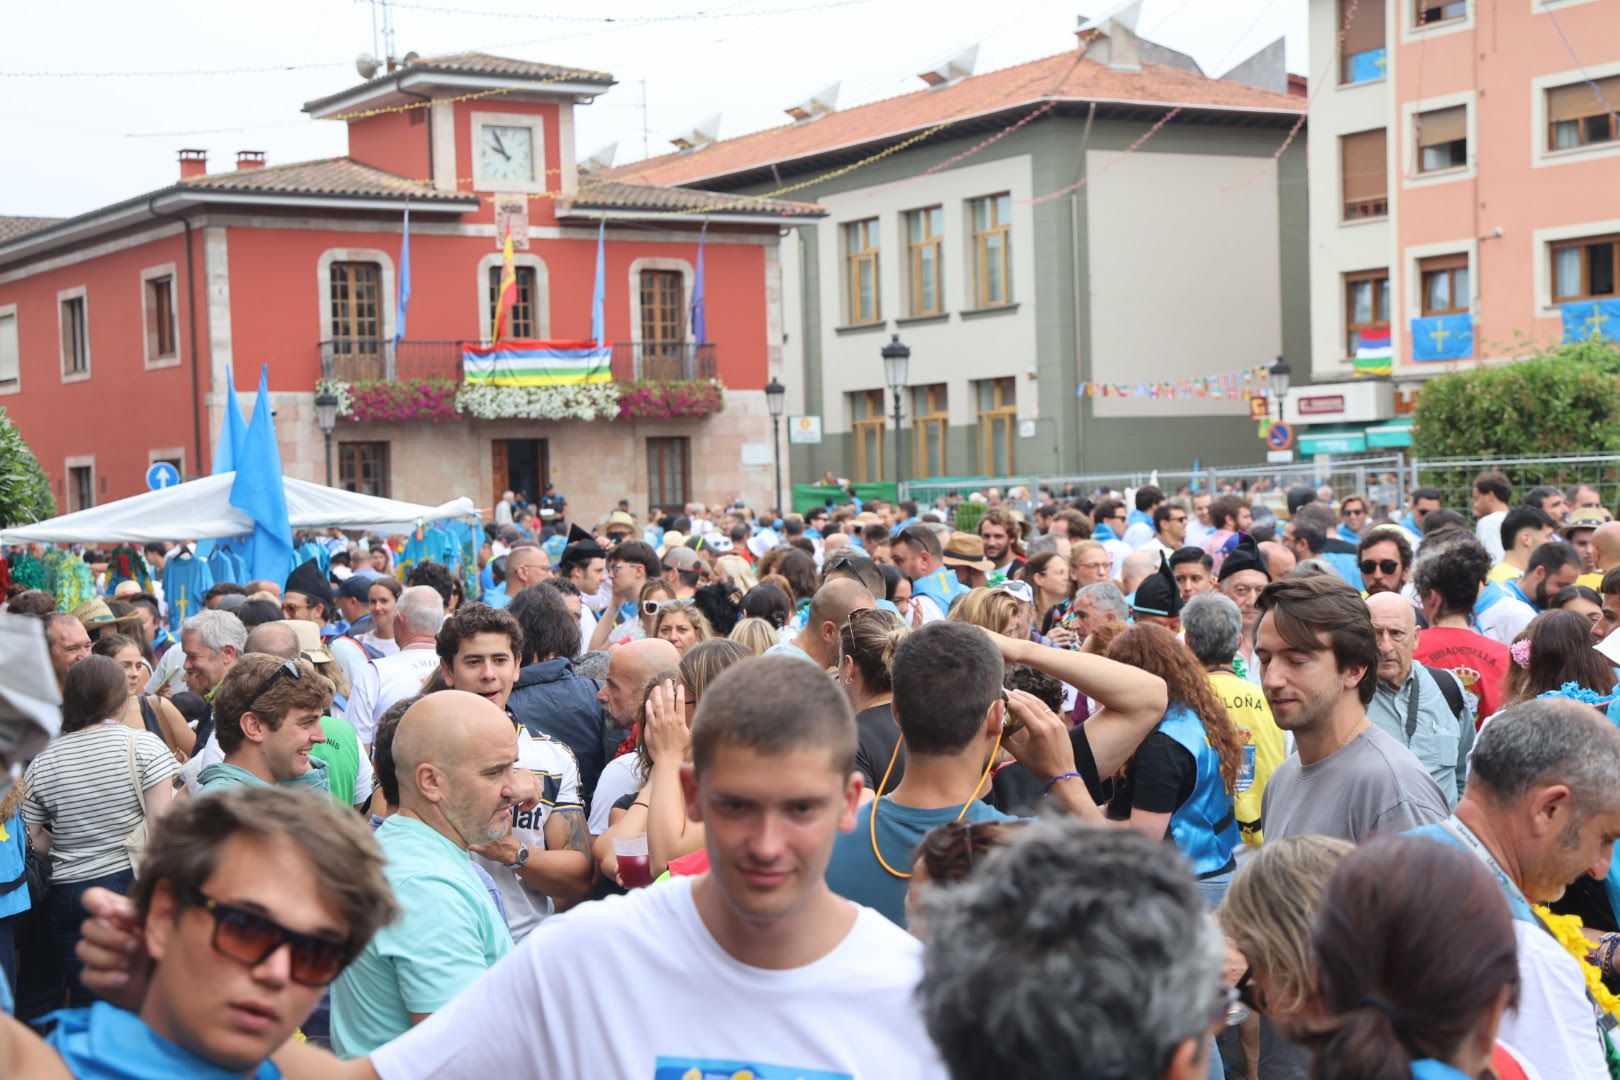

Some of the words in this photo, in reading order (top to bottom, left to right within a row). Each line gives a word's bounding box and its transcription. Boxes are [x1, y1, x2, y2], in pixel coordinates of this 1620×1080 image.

[1429, 646, 1497, 667] RIBADESELLA
[1223, 693, 1263, 711] LOÑA
[326, 737, 340, 750] NÍS
[512, 804, 542, 830] lat
